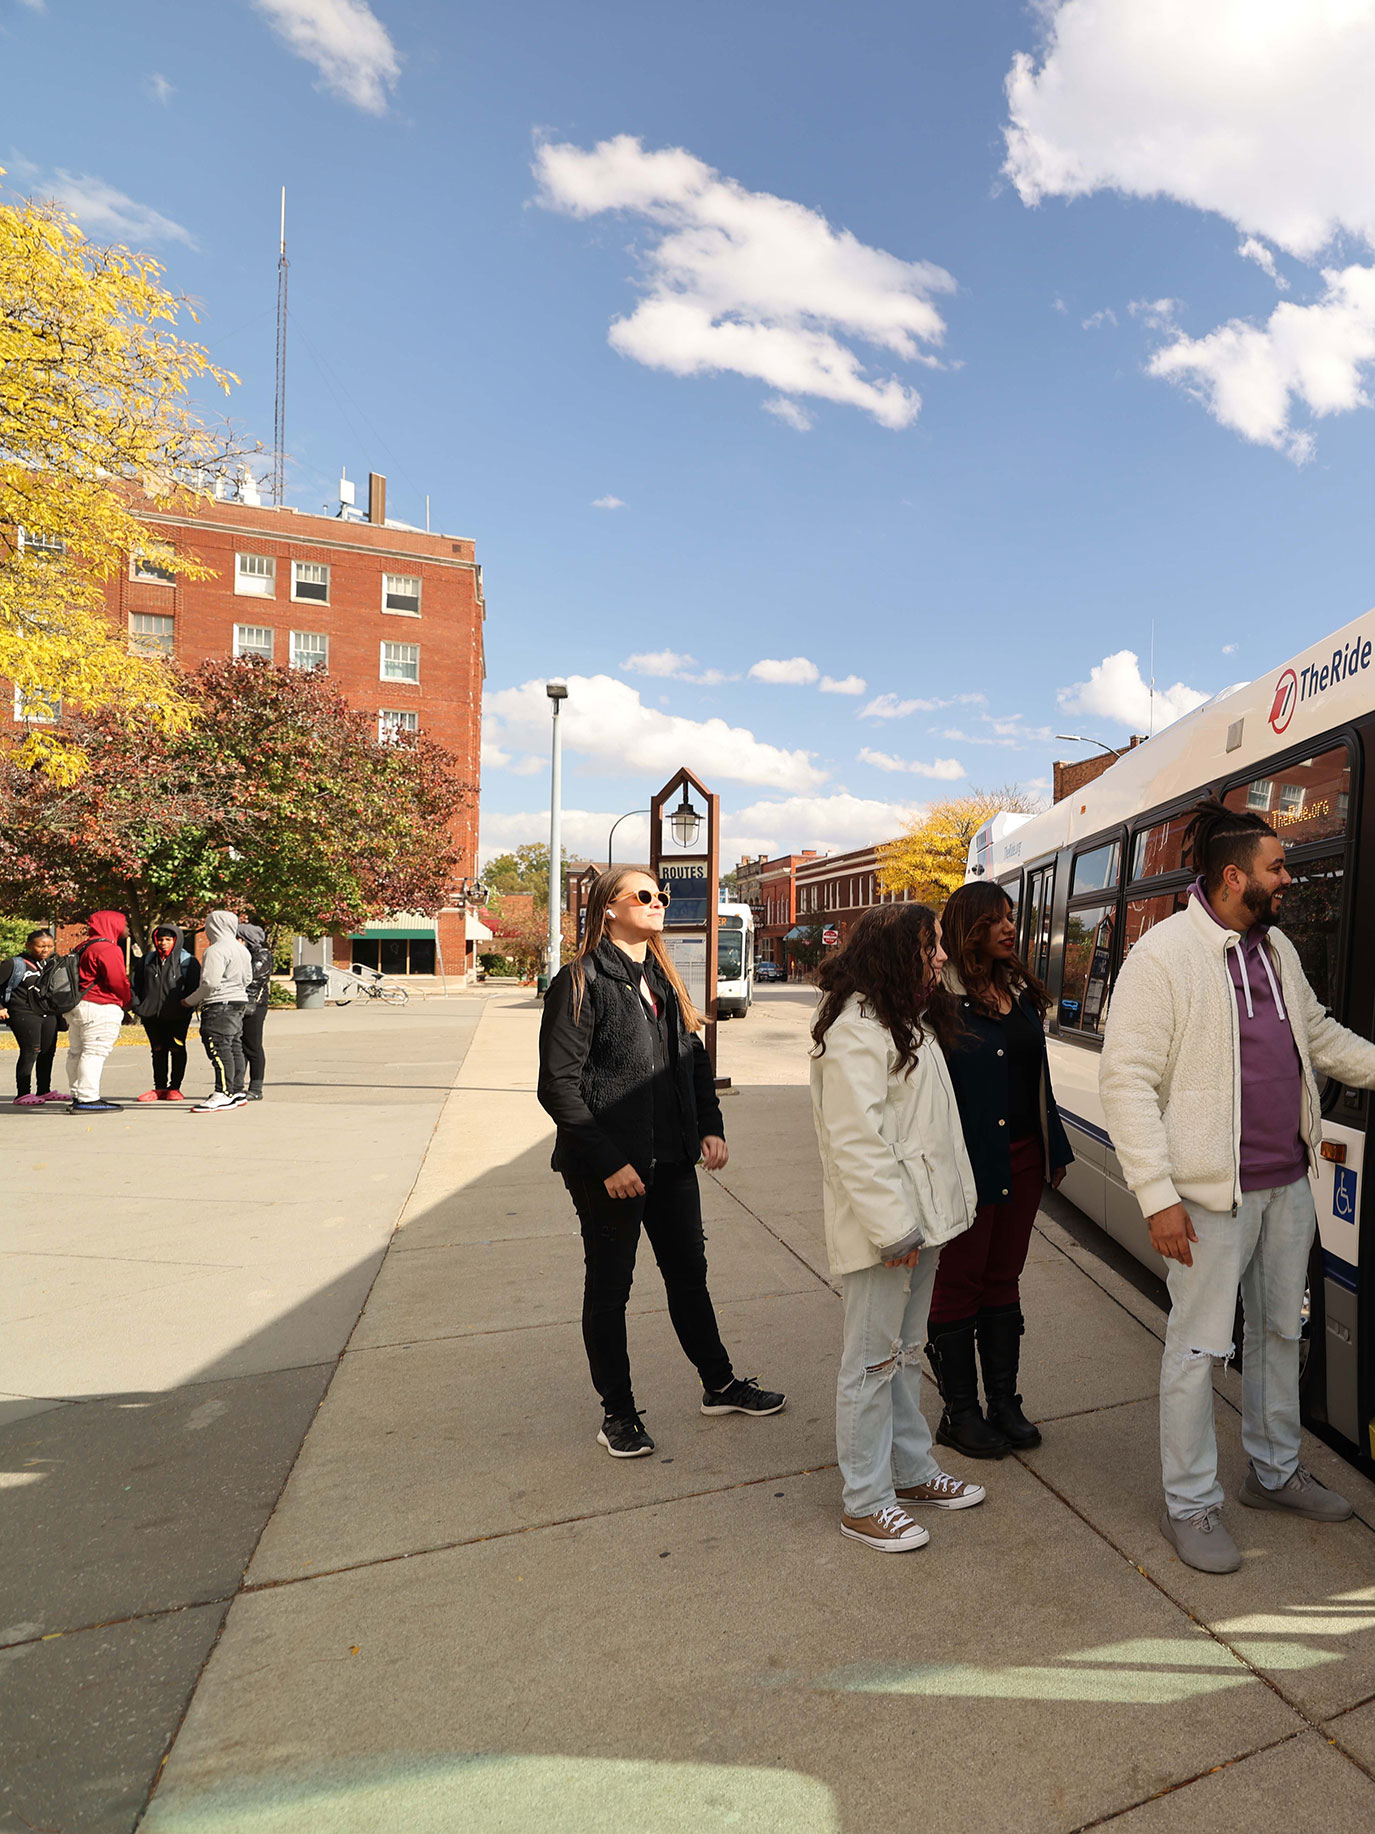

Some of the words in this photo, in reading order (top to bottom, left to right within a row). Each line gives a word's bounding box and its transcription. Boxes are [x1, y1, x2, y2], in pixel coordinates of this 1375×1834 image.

[1300, 636, 1372, 702] TheRide
[1272, 800, 1329, 830] TheRide.org
[662, 866, 704, 879] ROUTES
